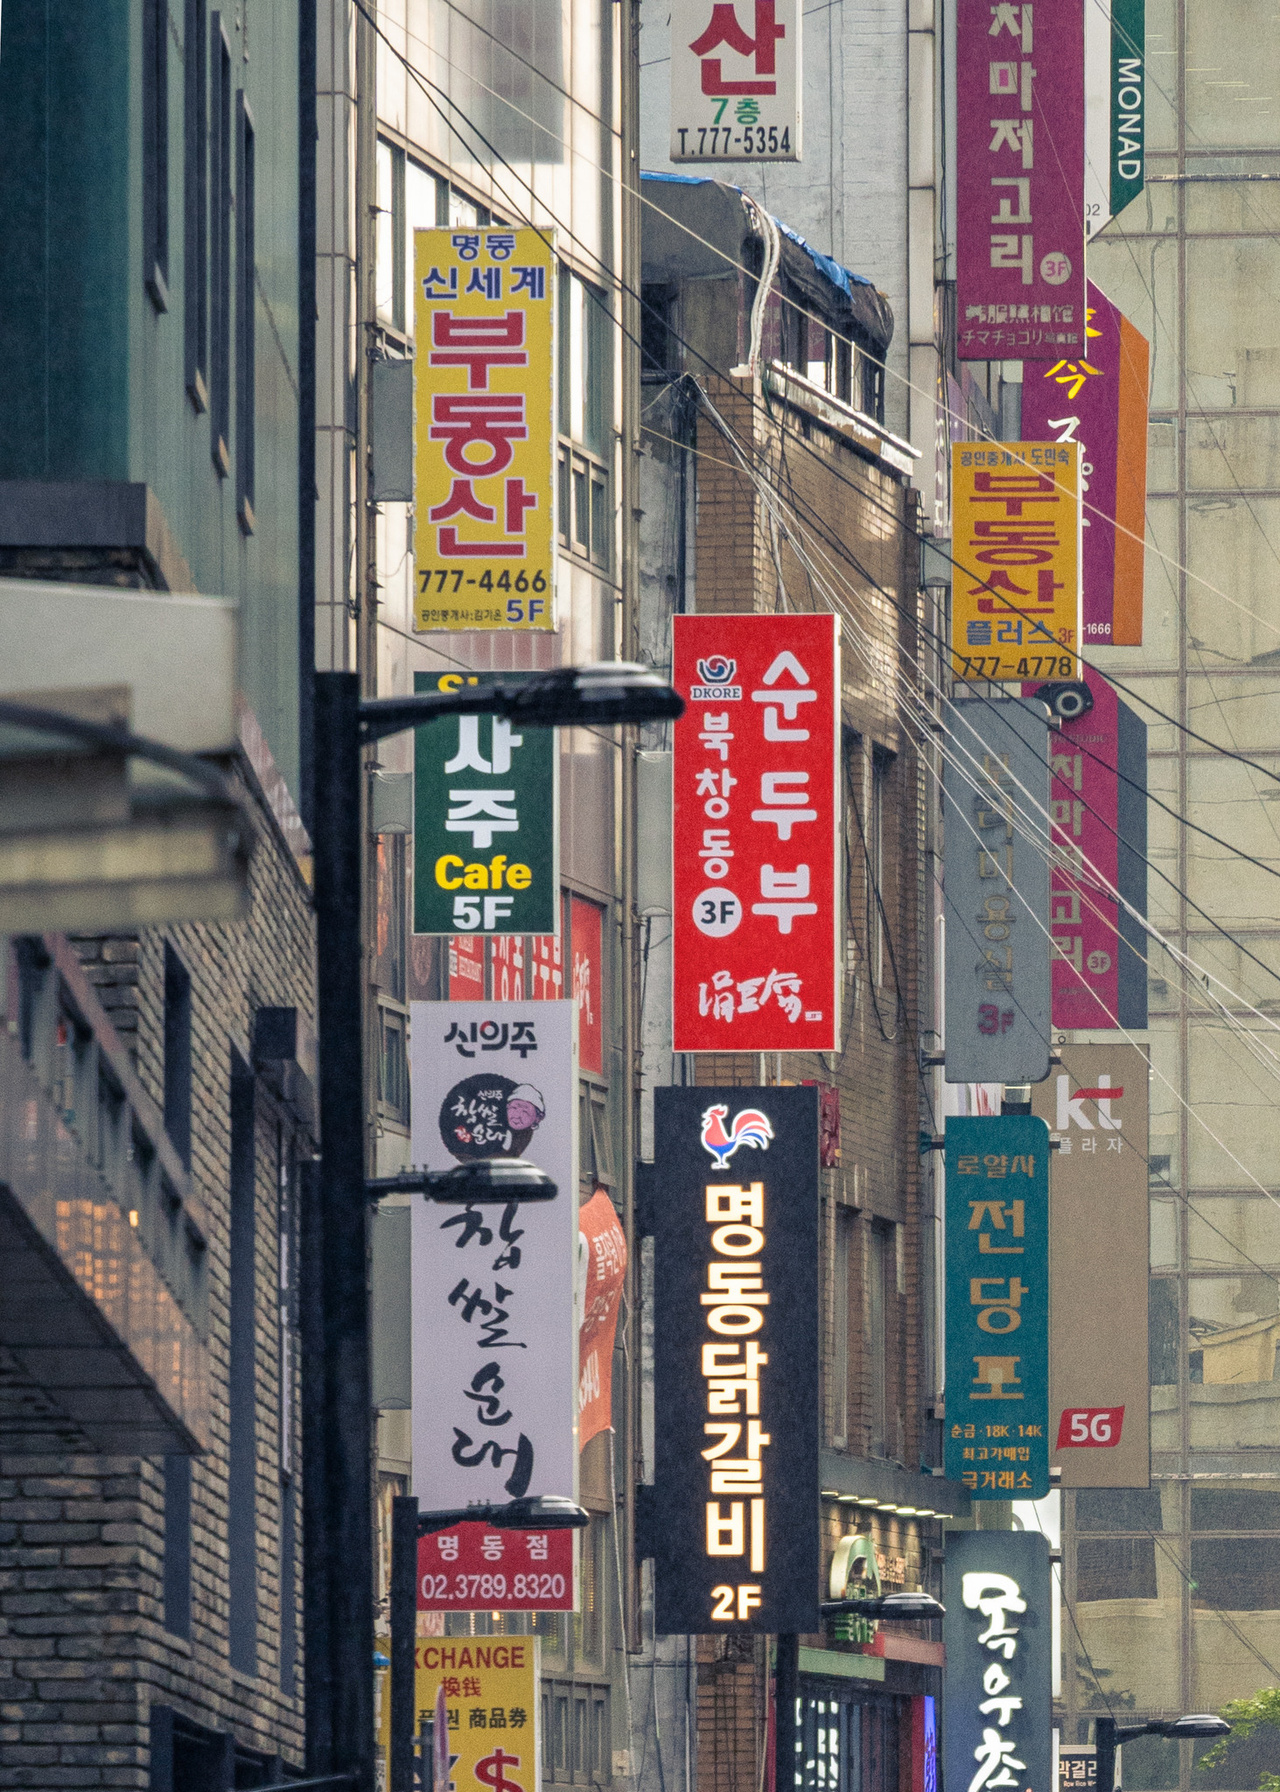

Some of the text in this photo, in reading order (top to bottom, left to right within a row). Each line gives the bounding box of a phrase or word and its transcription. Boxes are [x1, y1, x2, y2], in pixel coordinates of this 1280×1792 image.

[710, 98, 761, 125] 7층
[1118, 59, 1142, 180] MONAD
[677, 126, 791, 156] T.777-5354
[988, 3, 1037, 285] 치마저고리
[451, 234, 515, 261] 명동
[1045, 260, 1067, 277] 3F
[422, 266, 545, 300] 신세계
[428, 309, 537, 559] 부동산
[967, 472, 1065, 615] 부동산
[418, 570, 546, 593] 777-4466
[506, 600, 544, 623] 5F
[966, 620, 1057, 646] 플러스
[1058, 627, 1074, 644] 3F
[961, 656, 1072, 677] 777-4778
[692, 687, 740, 699] DKORE
[445, 716, 522, 849] 사주
[695, 712, 737, 879] 북창동
[751, 650, 818, 935] 순두부
[435, 855, 532, 890] Cafe
[452, 896, 514, 930] 5F
[700, 900, 736, 924] 3F
[1090, 956, 1108, 969] 3F
[977, 1003, 1015, 1036] 3F
[444, 1020, 538, 1059] 신의주
[1057, 1075, 1124, 1131] kt
[1058, 1137, 1124, 1155] 플라자
[968, 1200, 1029, 1400] 전당포
[700, 1182, 770, 1573] 명동닭갈비
[1070, 1413, 1112, 1442] 5G
[962, 1446, 1031, 1461] 최고가매입
[961, 1471, 1033, 1490] 금거래소
[437, 1535, 549, 1560] 명동점
[421, 1574, 565, 1600] 02.3789.8320
[711, 1586, 761, 1620] 2F
[414, 1646, 525, 1669] CHANGE
[469, 1708, 527, 1729] 商品券
